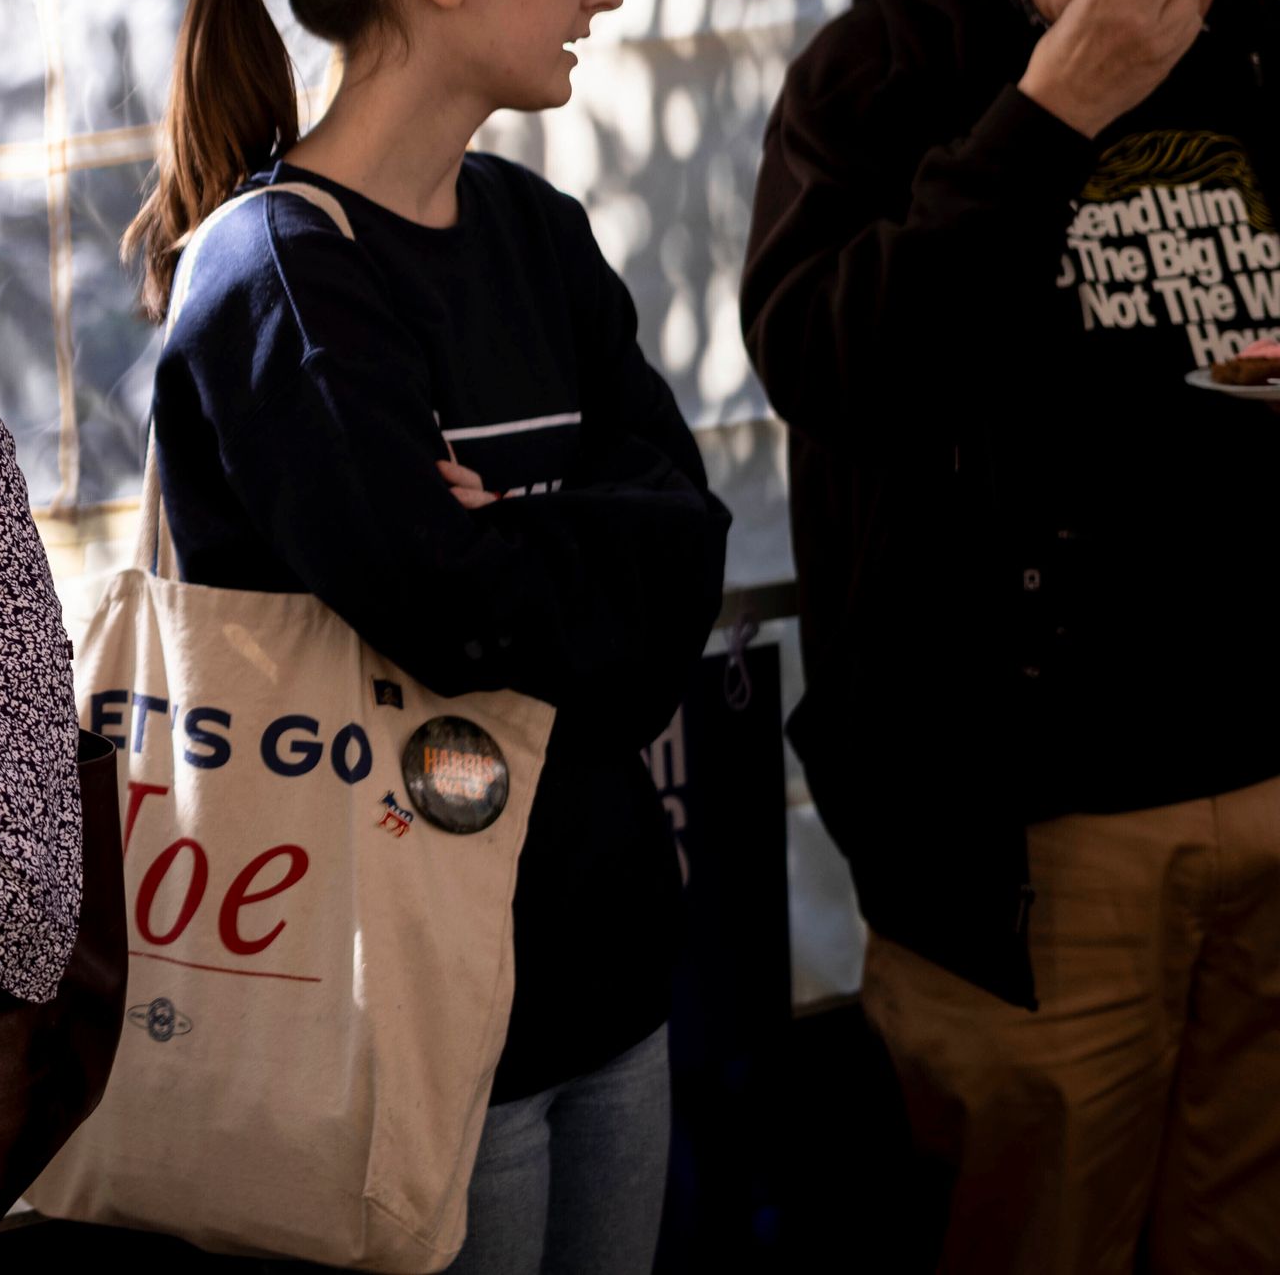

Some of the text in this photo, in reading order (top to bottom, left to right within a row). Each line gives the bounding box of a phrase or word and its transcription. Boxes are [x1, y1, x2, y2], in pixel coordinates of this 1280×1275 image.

[1155, 182, 1249, 230] Him
[1067, 237, 1148, 284] The
[1147, 227, 1223, 286] Big
[1078, 282, 1157, 331] Not
[1152, 276, 1237, 325] The
[91, 690, 373, 785] ET'S GO
